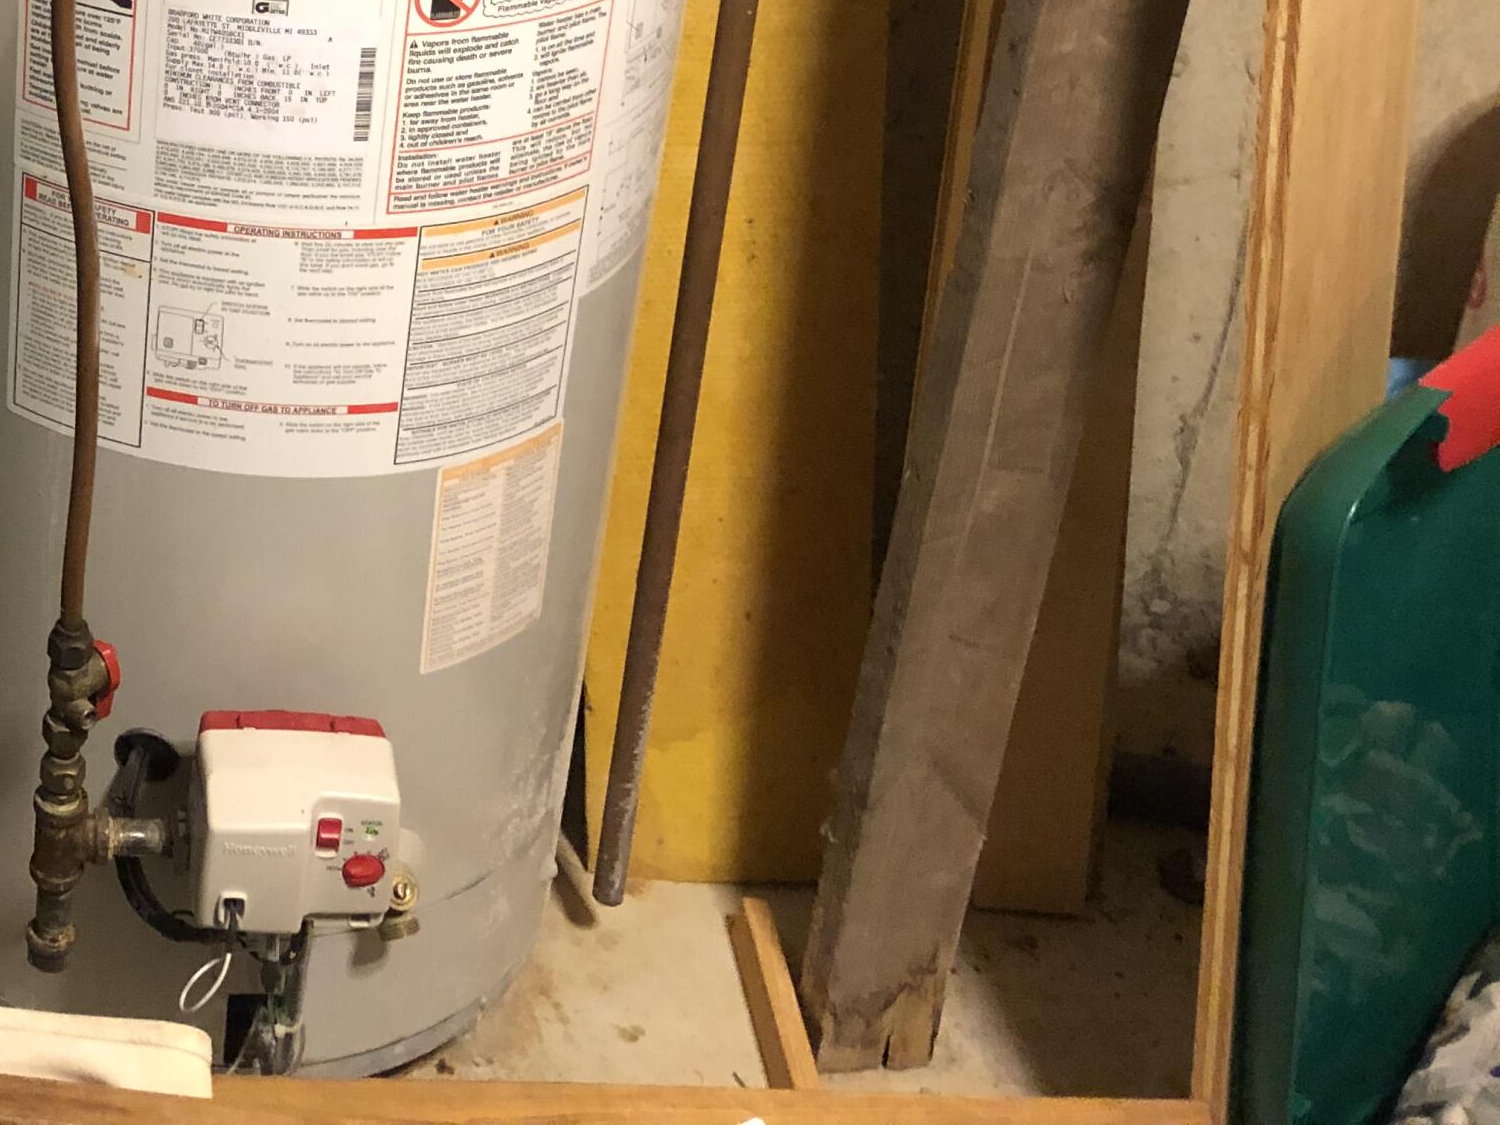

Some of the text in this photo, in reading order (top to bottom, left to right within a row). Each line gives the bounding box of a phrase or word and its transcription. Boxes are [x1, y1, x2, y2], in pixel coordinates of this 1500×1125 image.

[498, 0, 538, 12] Flammable
[471, 32, 509, 42] flammable
[453, 44, 483, 53] explode
[500, 39, 519, 47] catch
[489, 49, 512, 57] severe
[474, 68, 507, 78] flammable
[405, 85, 437, 93] products
[233, 226, 341, 239] OPERATING INSTRUCTIONS
[222, 401, 241, 411] TURN
